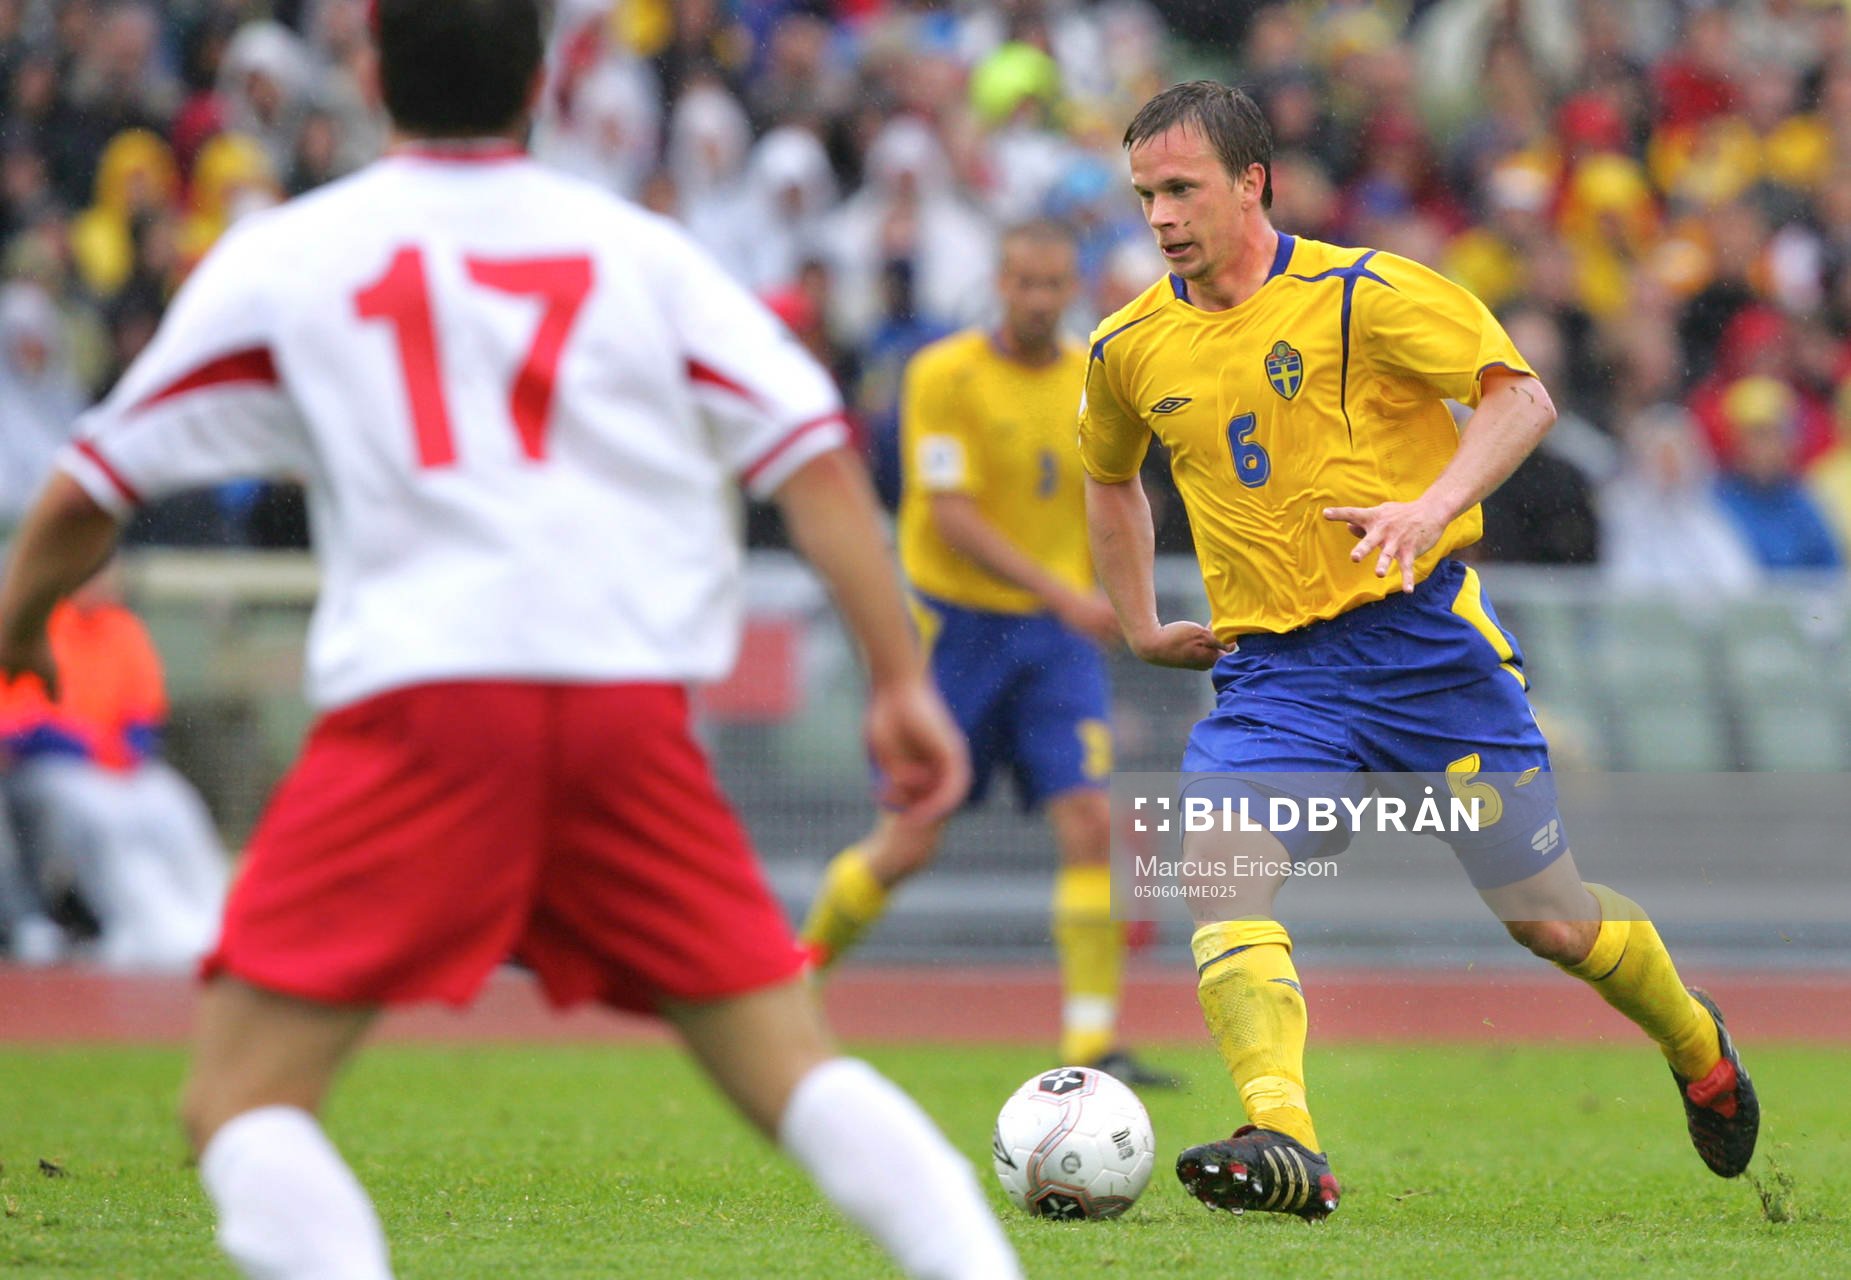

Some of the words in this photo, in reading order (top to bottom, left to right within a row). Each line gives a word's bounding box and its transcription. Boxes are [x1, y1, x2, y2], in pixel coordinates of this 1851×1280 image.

[354, 246, 595, 466] 17
[1227, 412, 1271, 488] 6
[1445, 753, 1503, 828] 6
